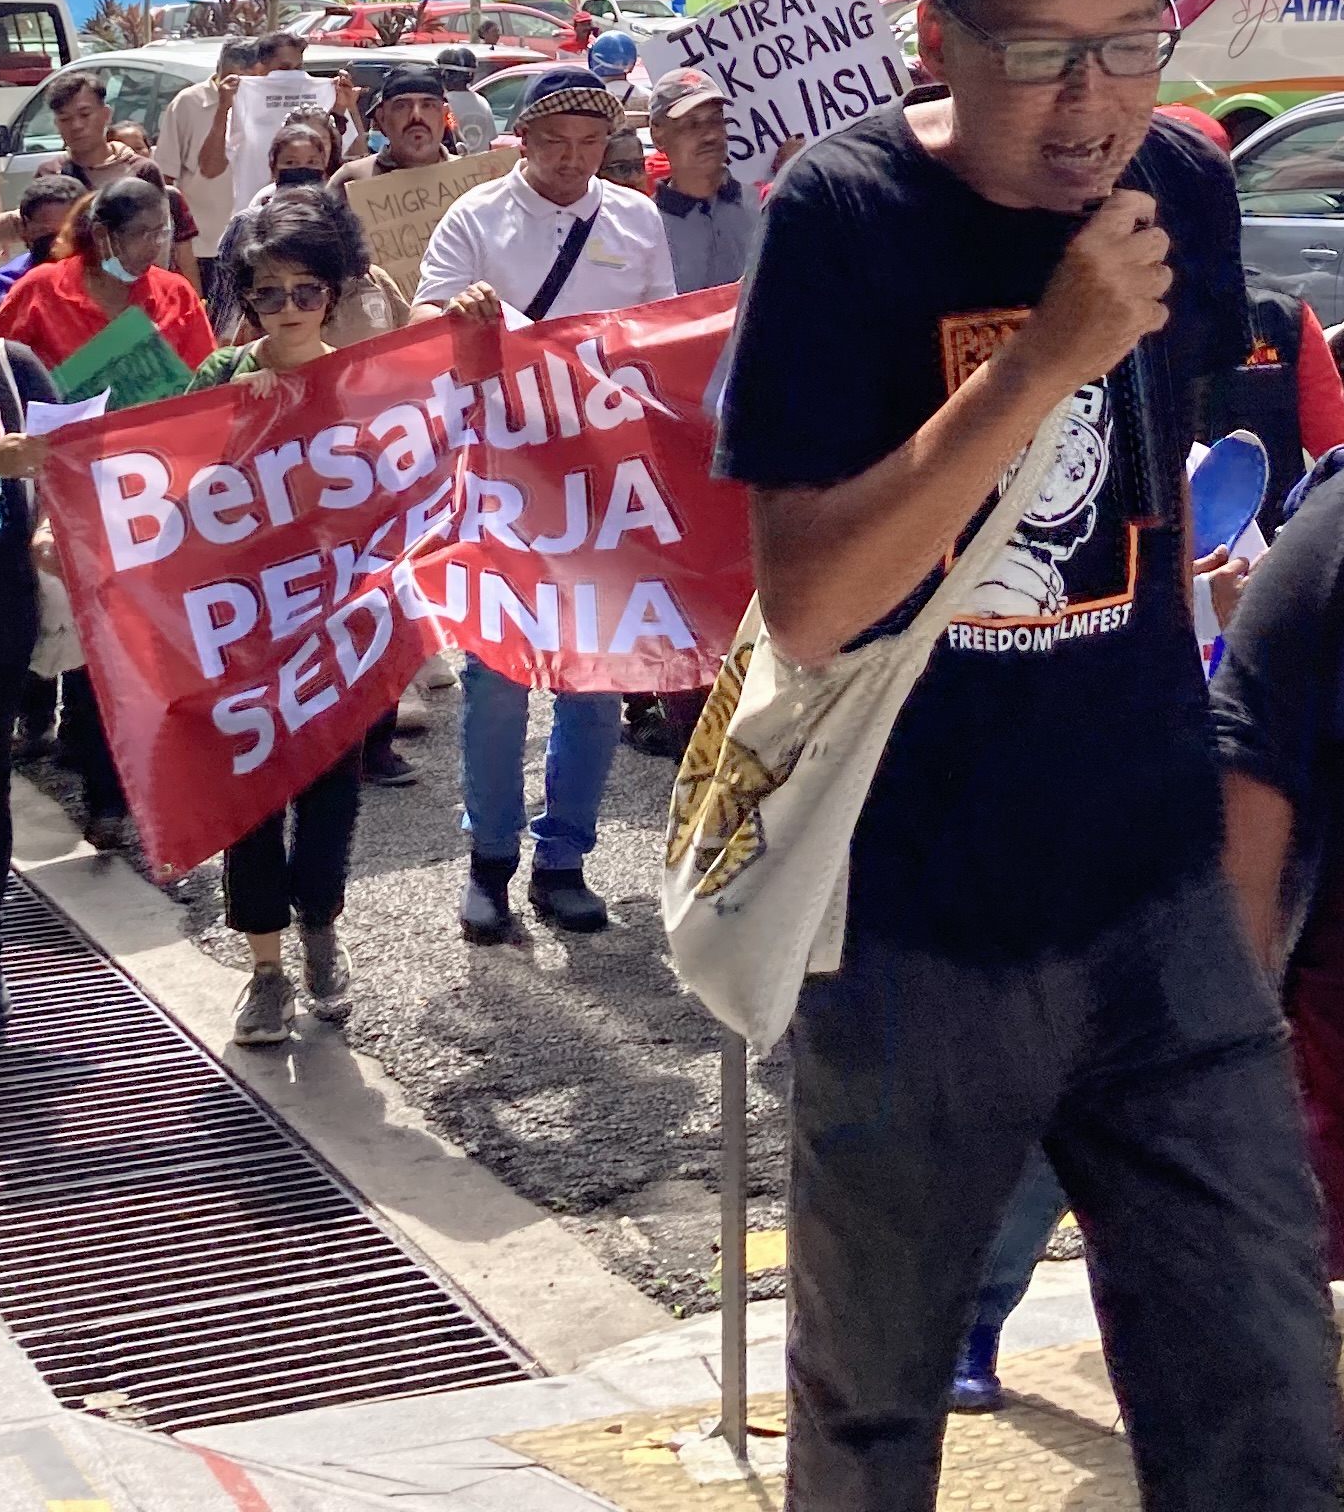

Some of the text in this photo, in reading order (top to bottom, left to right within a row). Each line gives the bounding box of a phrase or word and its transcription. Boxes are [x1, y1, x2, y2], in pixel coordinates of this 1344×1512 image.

[702, 0, 875, 98] K ORANG
[369, 219, 441, 266] RIGH
[182, 456, 684, 679] PEKERJA
[212, 560, 698, 776] SEDUNIA
[948, 624, 1052, 652] FREEDOM
